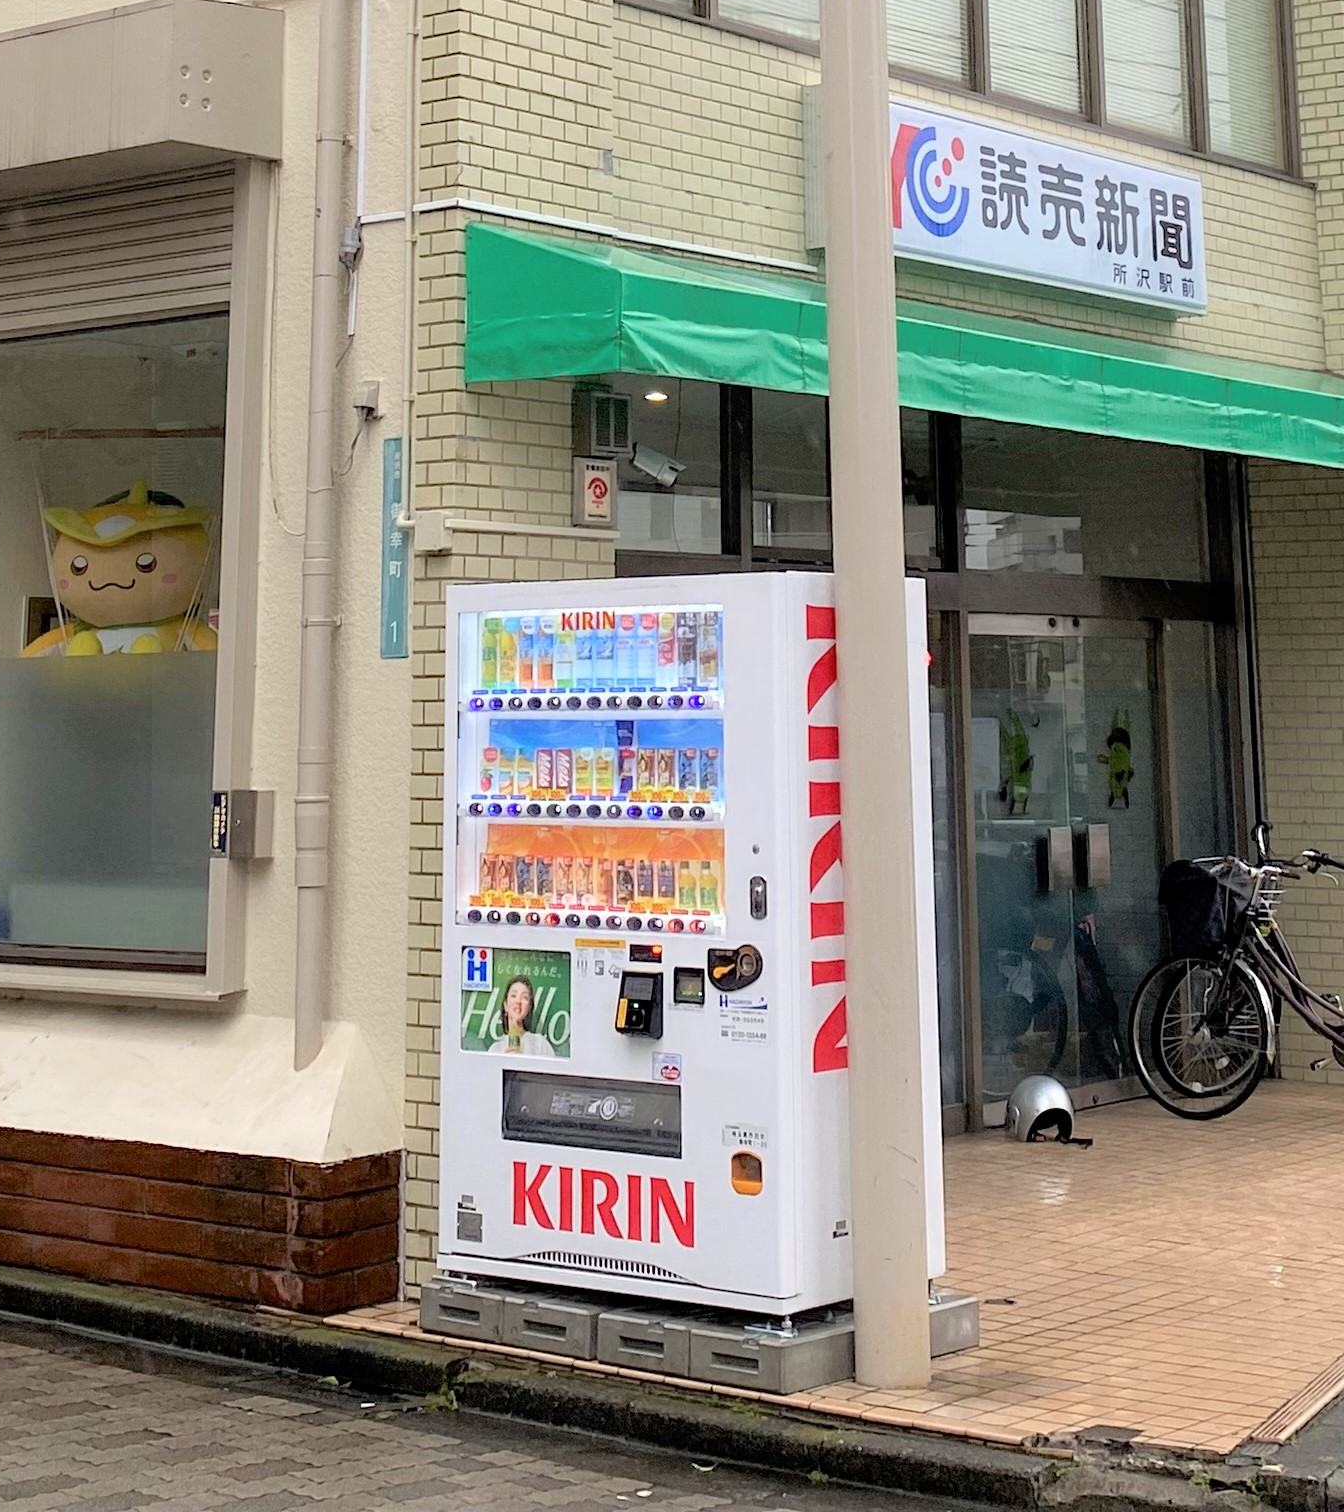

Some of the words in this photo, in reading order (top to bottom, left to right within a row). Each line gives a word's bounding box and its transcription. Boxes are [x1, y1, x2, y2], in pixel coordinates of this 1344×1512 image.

[979, 145, 1194, 271] 読売新聞
[1111, 262, 1196, 300] 所沢駅前
[390, 620, 398, 644] 1
[561, 611, 615, 631] KIRIN
[510, 1160, 697, 1249] KIRIN
